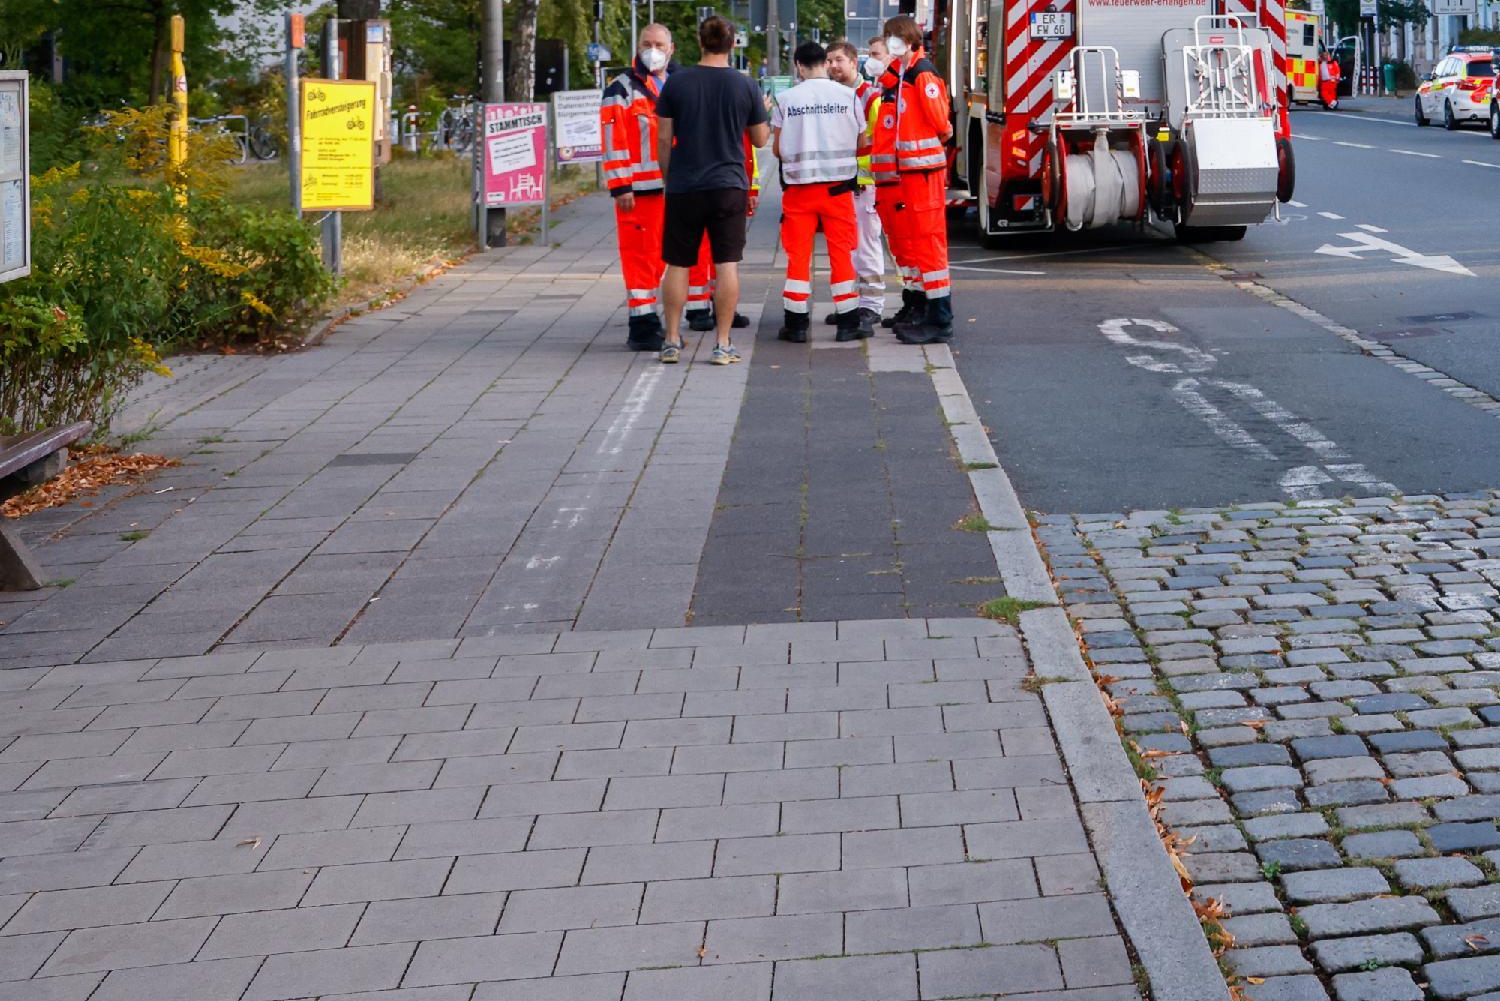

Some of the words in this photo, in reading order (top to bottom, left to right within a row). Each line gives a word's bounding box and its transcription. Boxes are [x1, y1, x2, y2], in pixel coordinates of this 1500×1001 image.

[1042, 14, 1056, 24] ER
[1036, 25, 1050, 35] FW
[787, 102, 849, 118] Abschnittsleiter
[489, 114, 543, 133] STAMMTISCH
